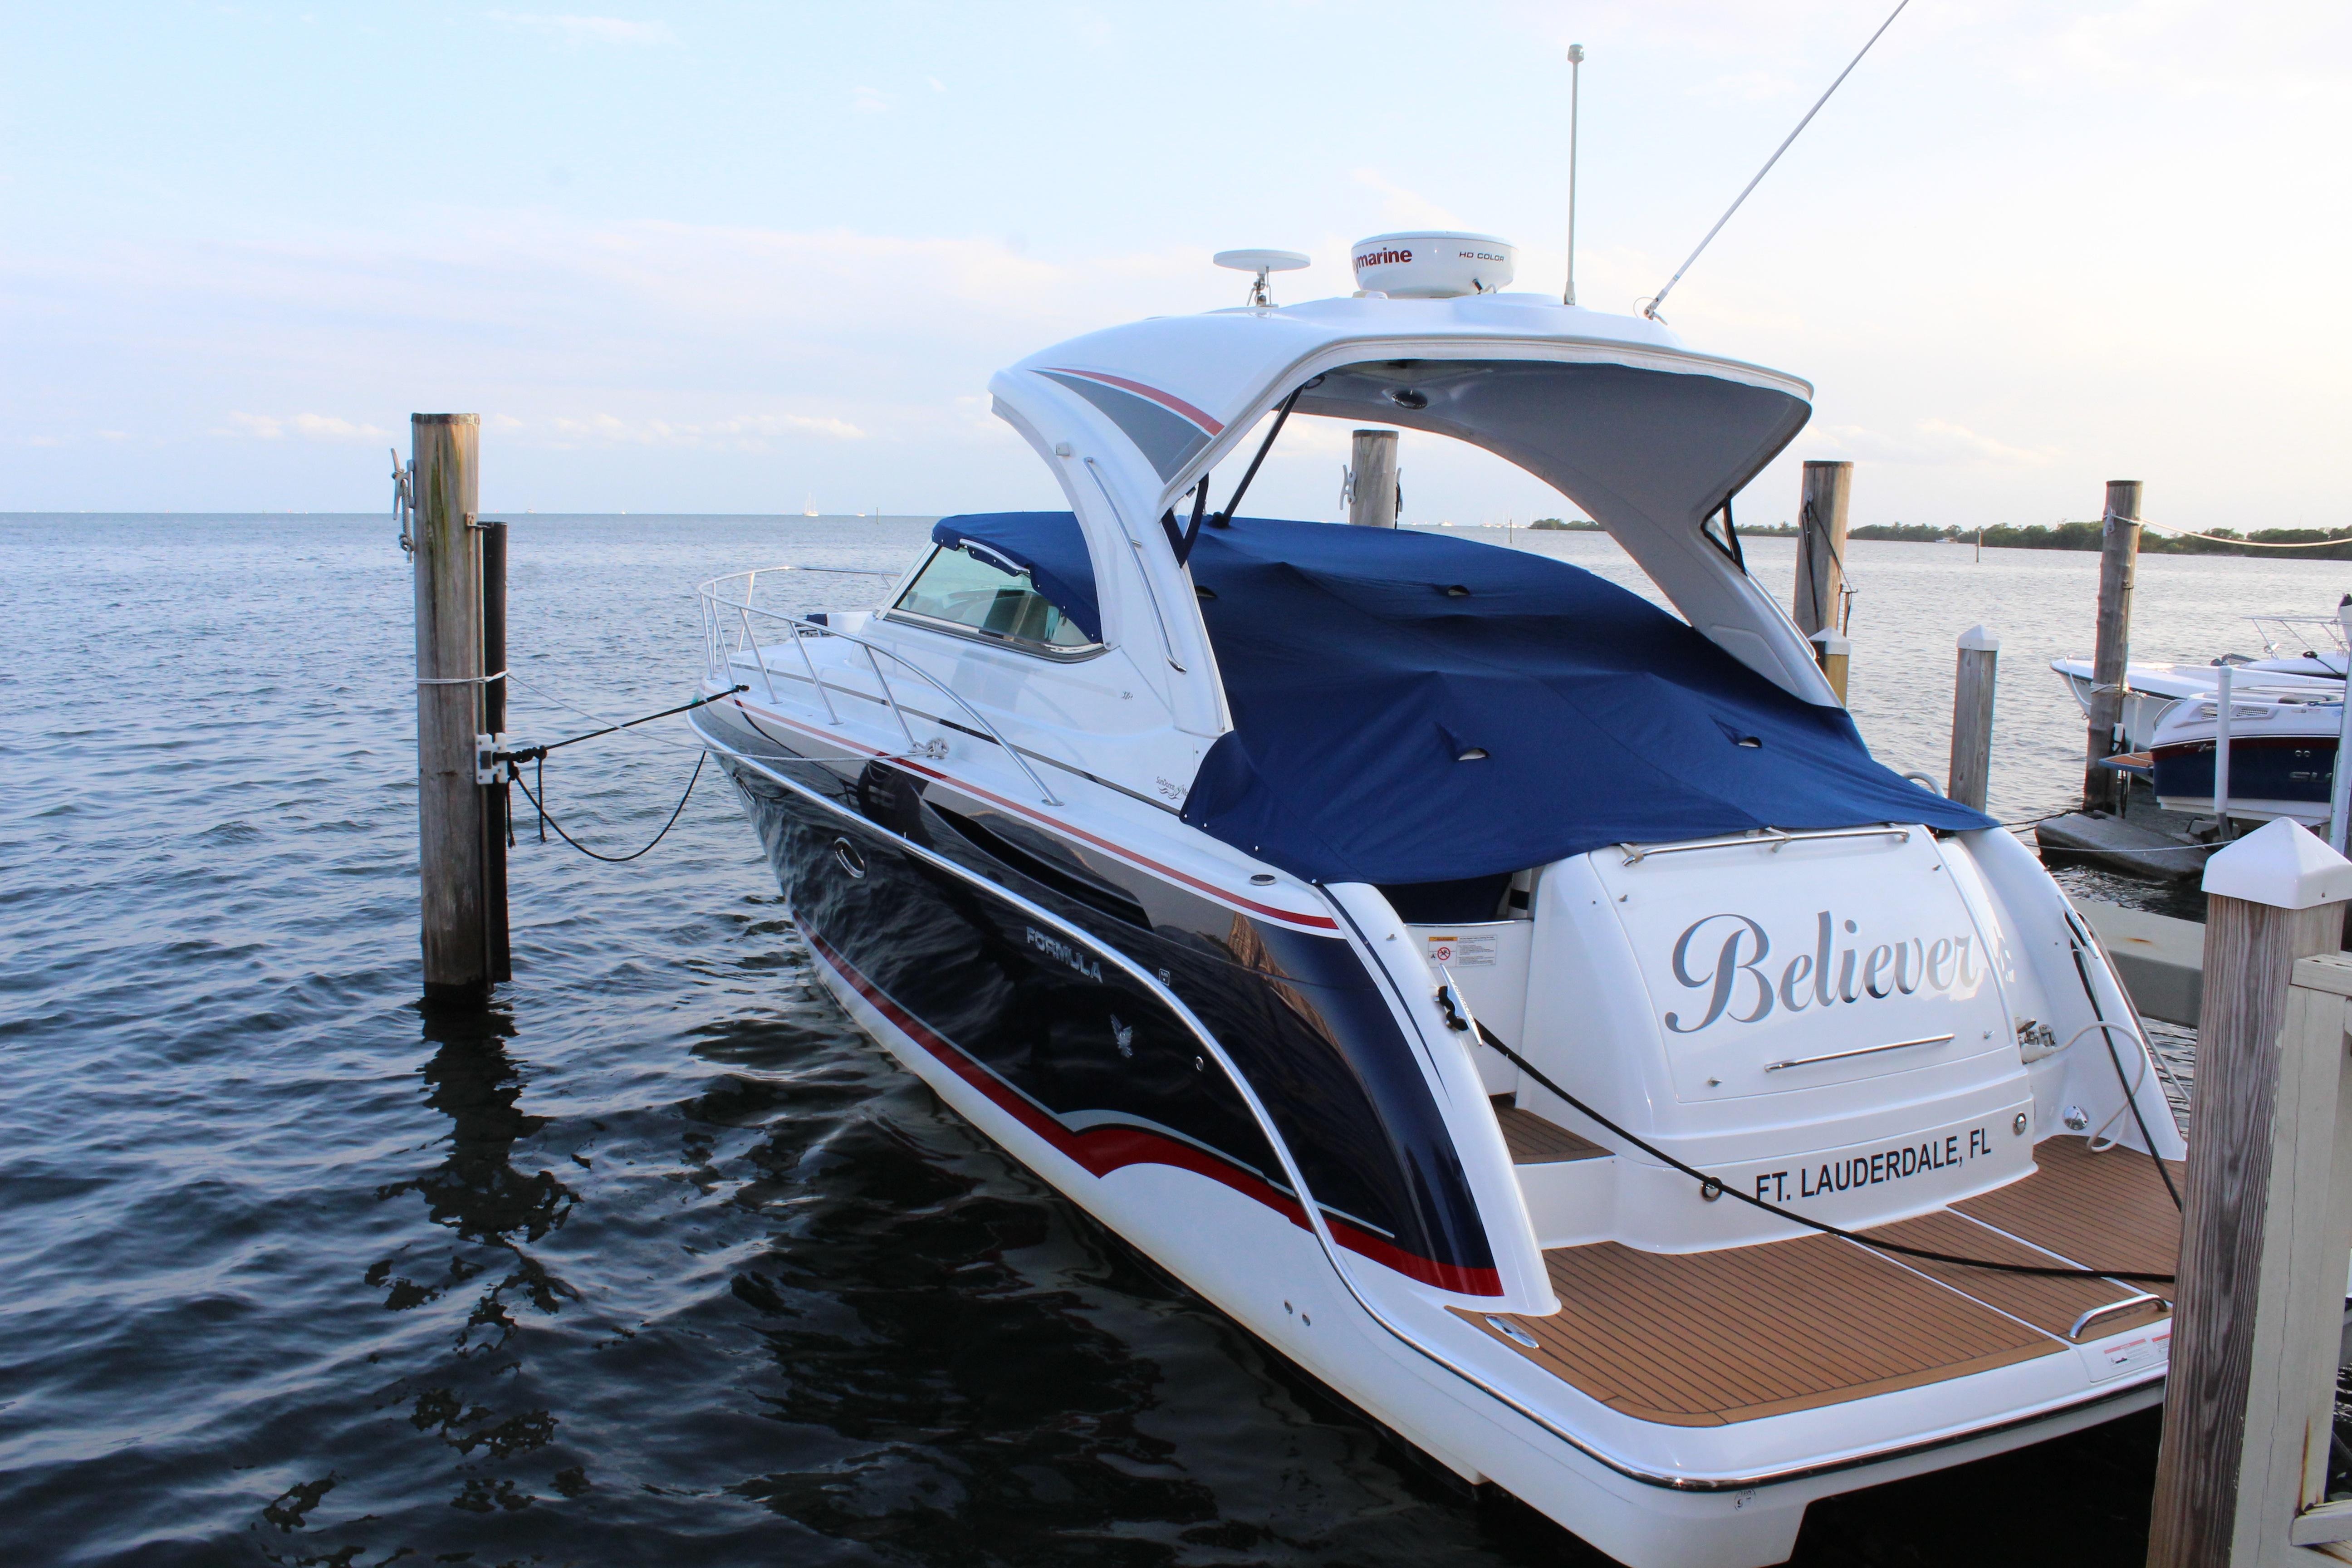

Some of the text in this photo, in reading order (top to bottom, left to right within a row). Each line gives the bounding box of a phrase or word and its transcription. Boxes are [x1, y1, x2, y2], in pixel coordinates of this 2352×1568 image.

[1477, 253, 1504, 262] COLOR
[1156, 776, 1175, 790] SunDance
[1026, 926, 1103, 984] FORMULA
[1665, 911, 1979, 1033] Believer
[1756, 1128, 1991, 1202] FT. LAUDERDALE, FL
